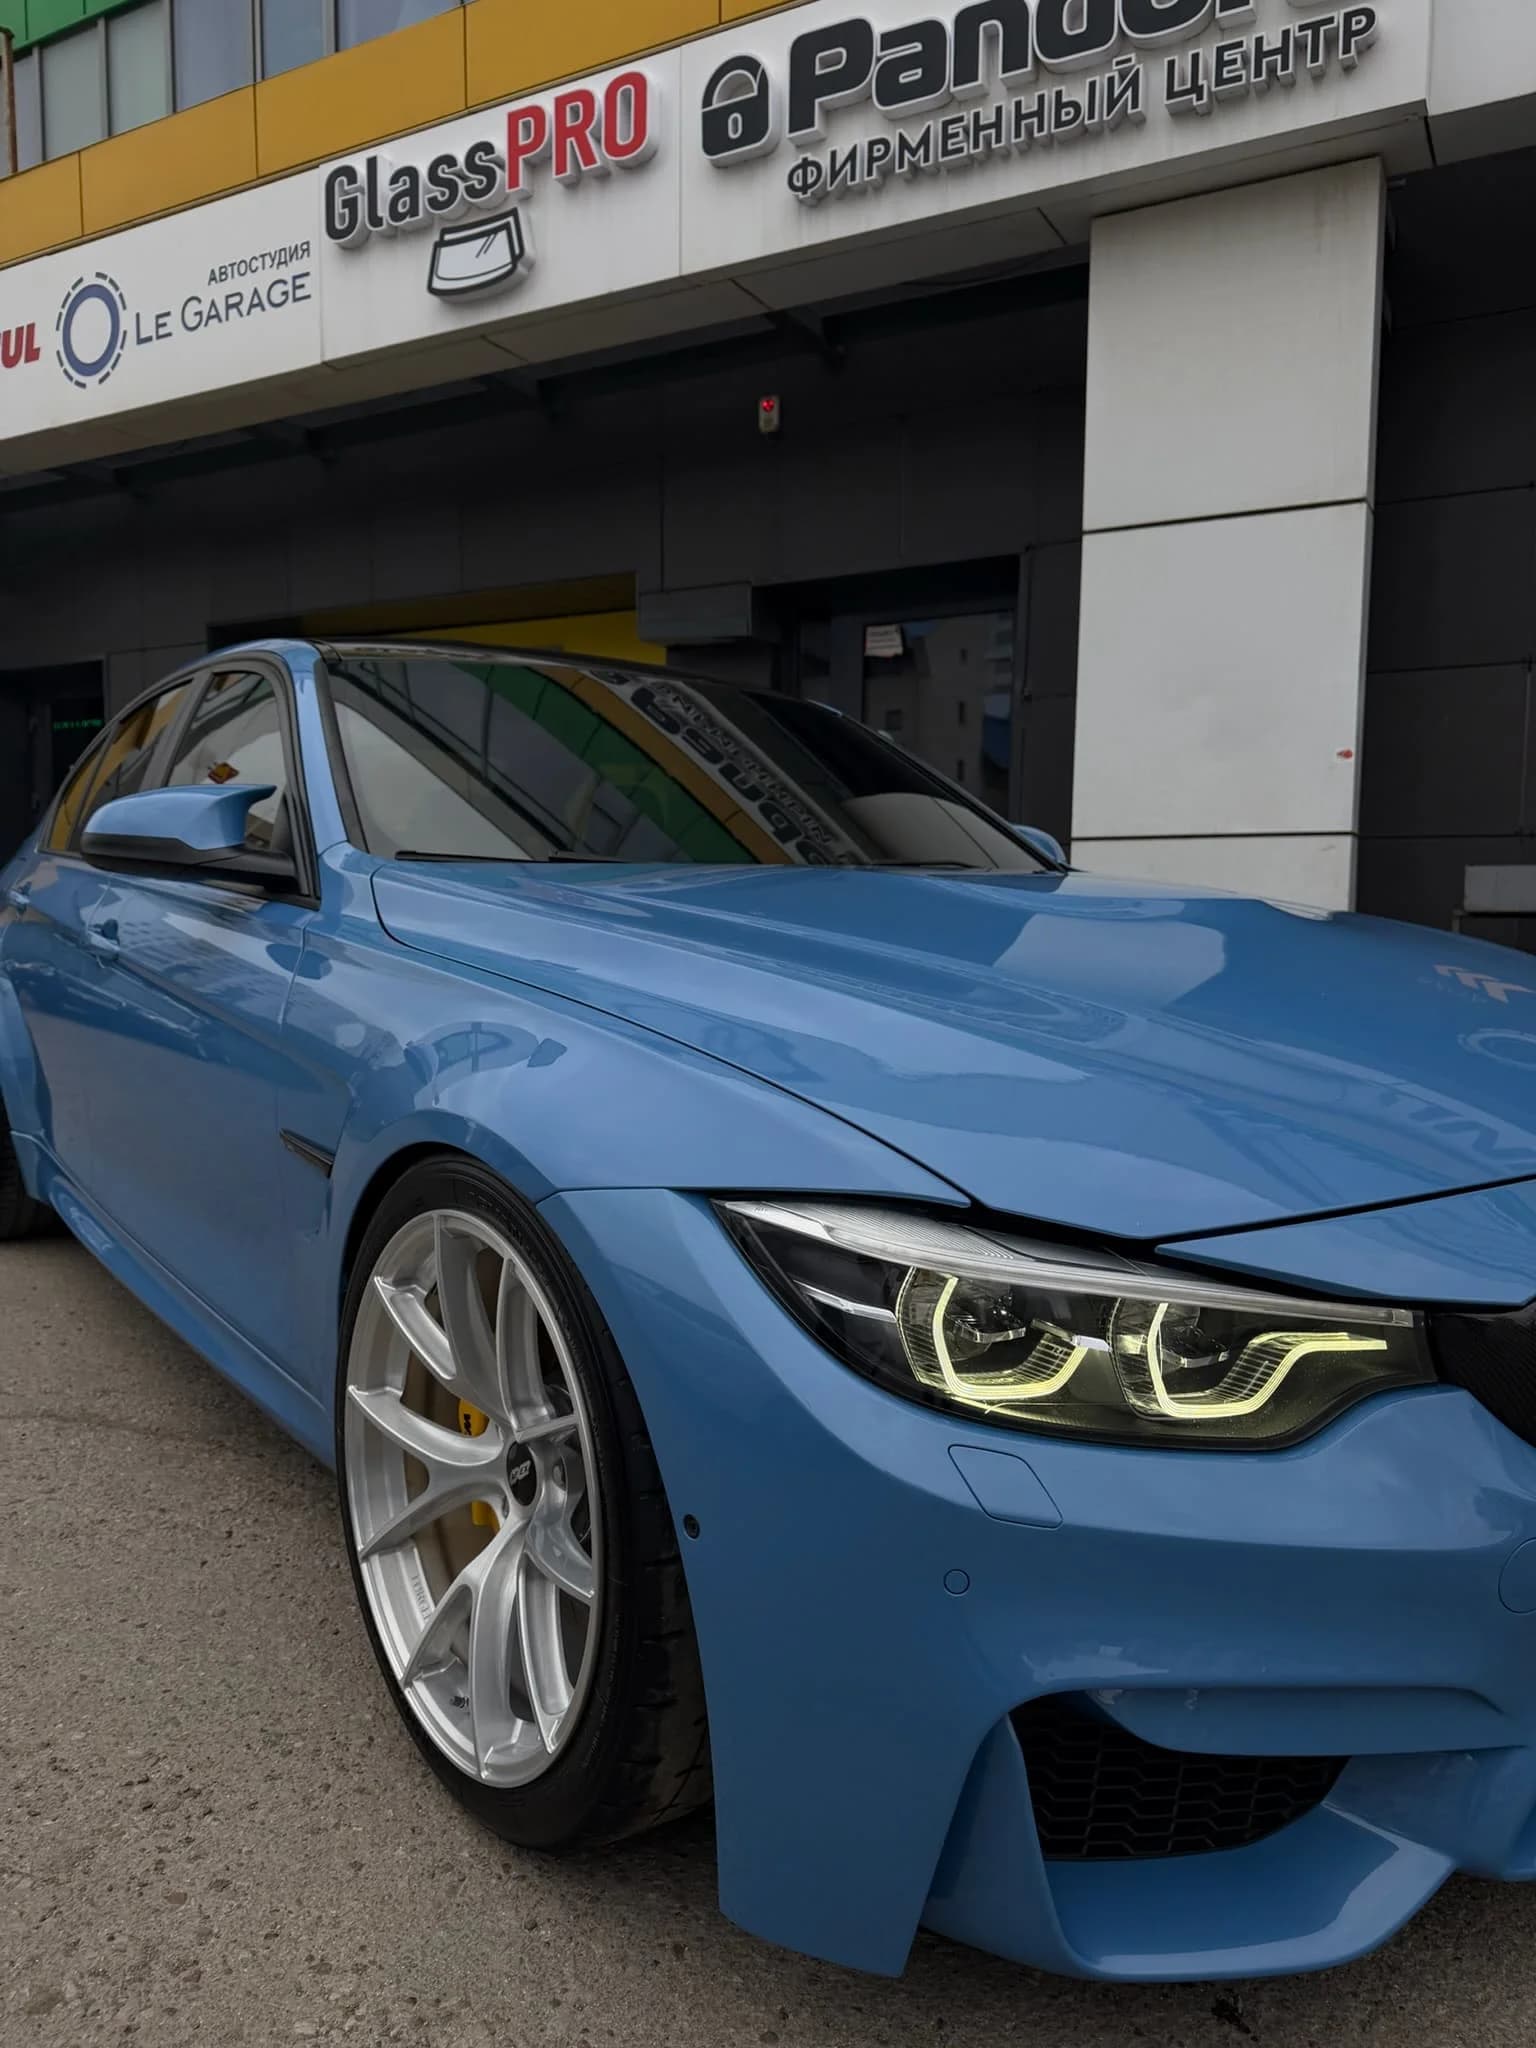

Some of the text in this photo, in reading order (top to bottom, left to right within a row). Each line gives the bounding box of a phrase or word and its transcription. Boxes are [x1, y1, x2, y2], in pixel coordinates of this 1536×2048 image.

[787, 0, 1254, 138] Pand
[787, 6, 1377, 196] ФИРМЕННЫЙ ЦЕНТР
[324, 71, 648, 240] GlassPRO
[207, 240, 311, 286] АВТОСТУДИЯ
[0, 322, 41, 369] UL
